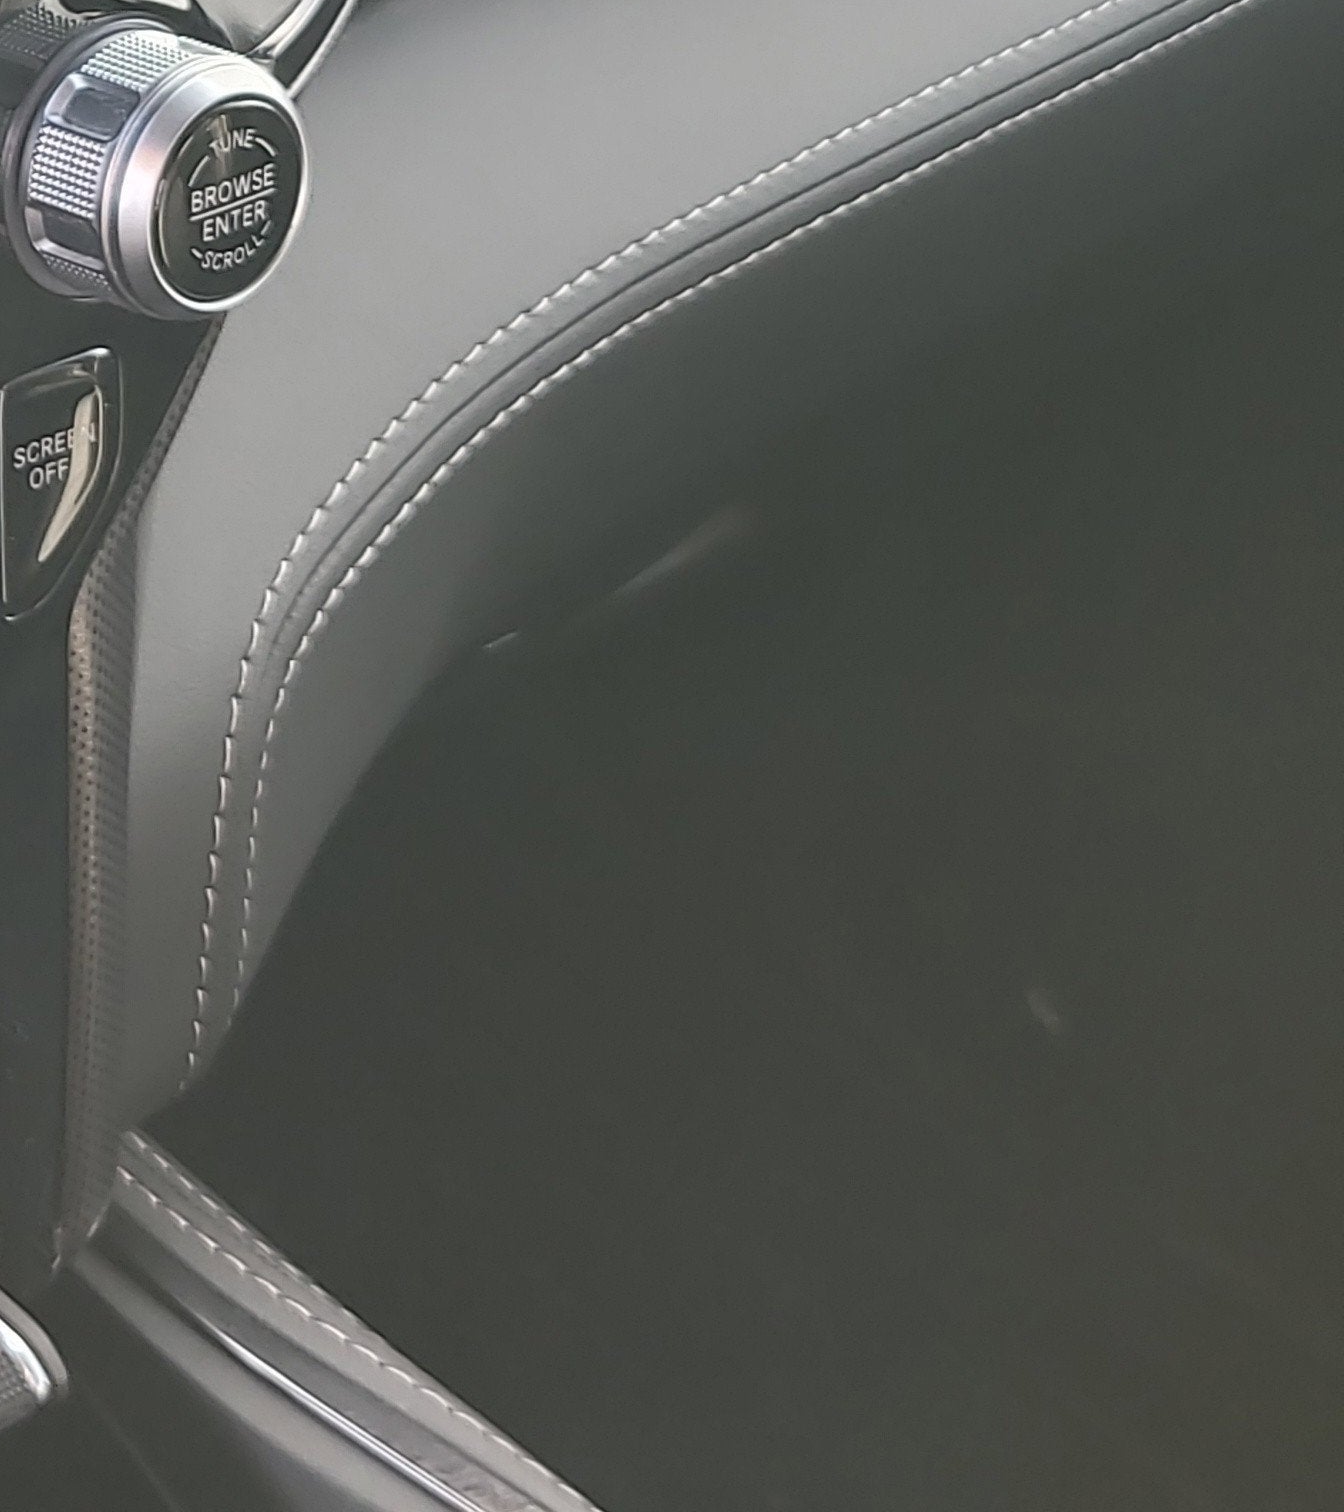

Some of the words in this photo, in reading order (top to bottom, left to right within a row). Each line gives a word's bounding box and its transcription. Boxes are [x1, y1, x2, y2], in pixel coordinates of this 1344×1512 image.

[209, 128, 256, 157] TUNE
[191, 163, 276, 213] BROWSE
[202, 200, 266, 242] ENTER
[201, 235, 265, 271] SCROLL
[29, 457, 69, 489] OFF
